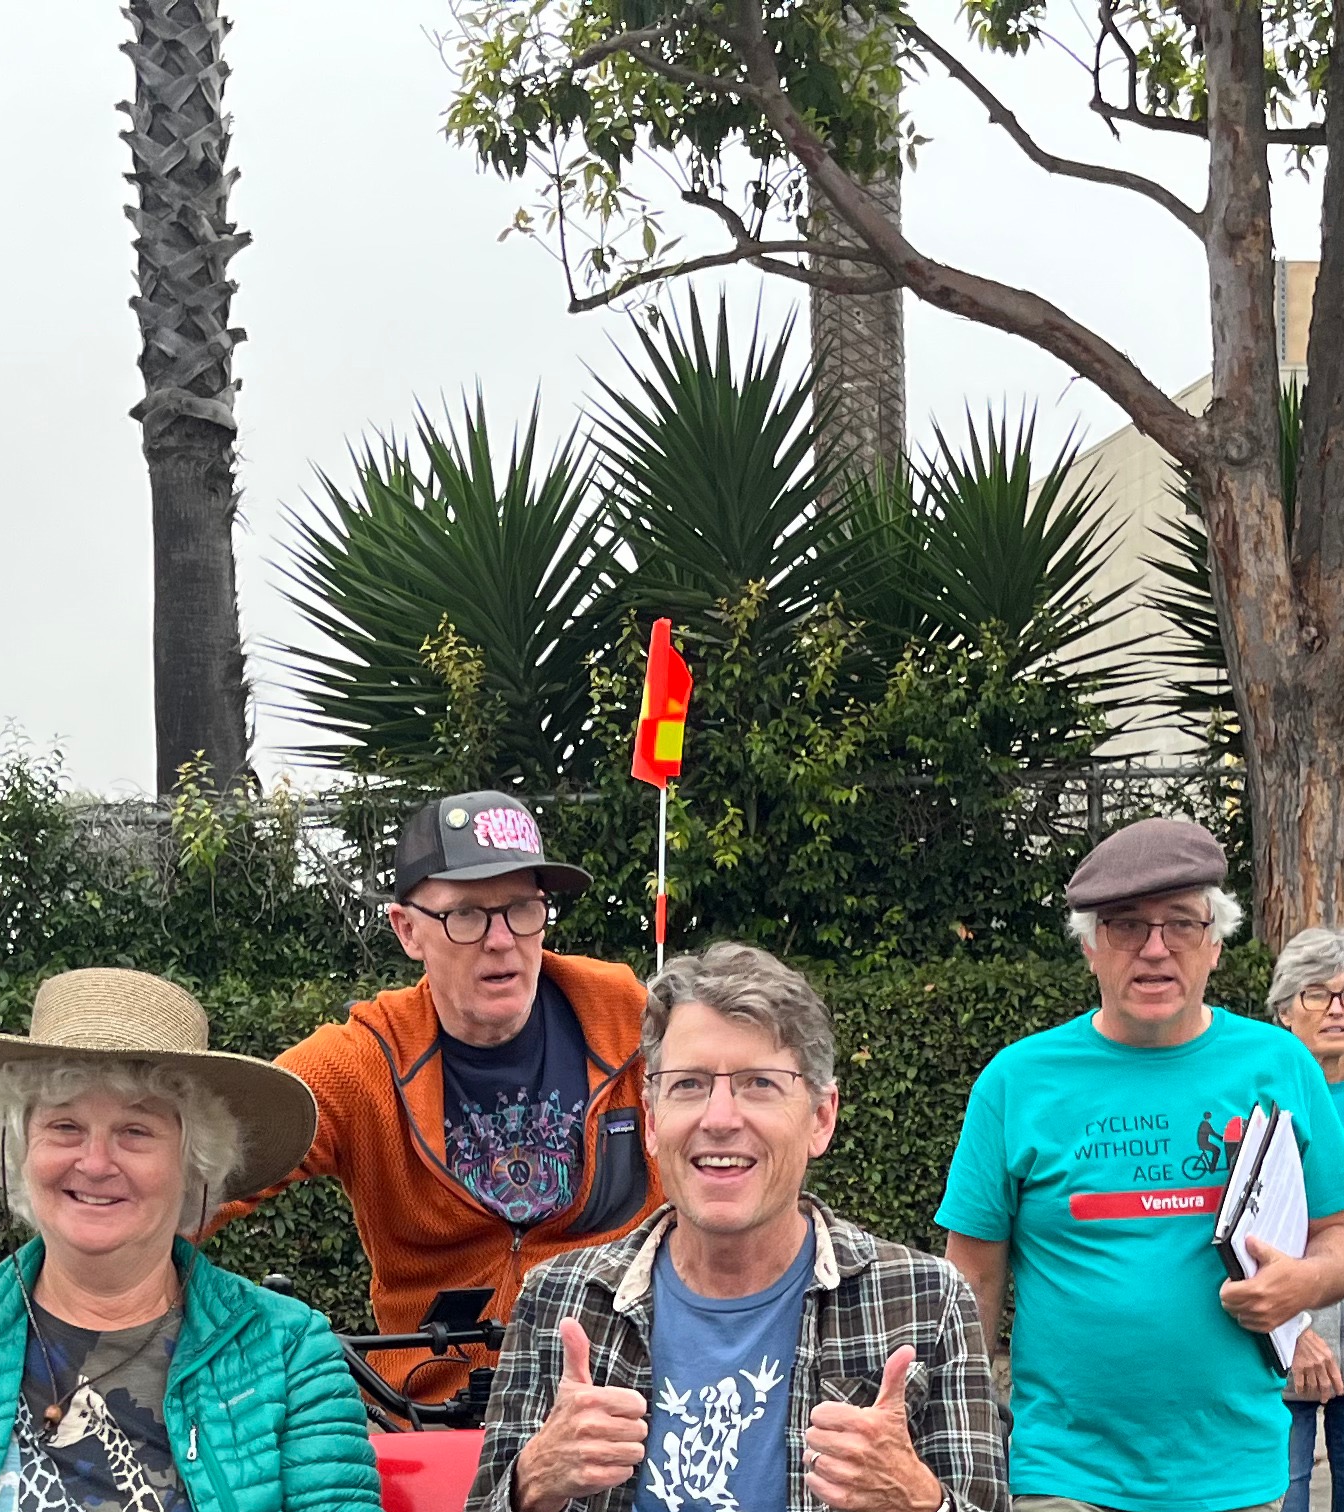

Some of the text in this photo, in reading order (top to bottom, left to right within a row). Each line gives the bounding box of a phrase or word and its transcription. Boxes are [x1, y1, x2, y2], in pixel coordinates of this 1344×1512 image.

[1086, 1114, 1169, 1136] CYCLING
[1074, 1138, 1171, 1160] WITHOUT
[1133, 1164, 1174, 1182] AGE
[1141, 1195, 1204, 1210] Ventura
